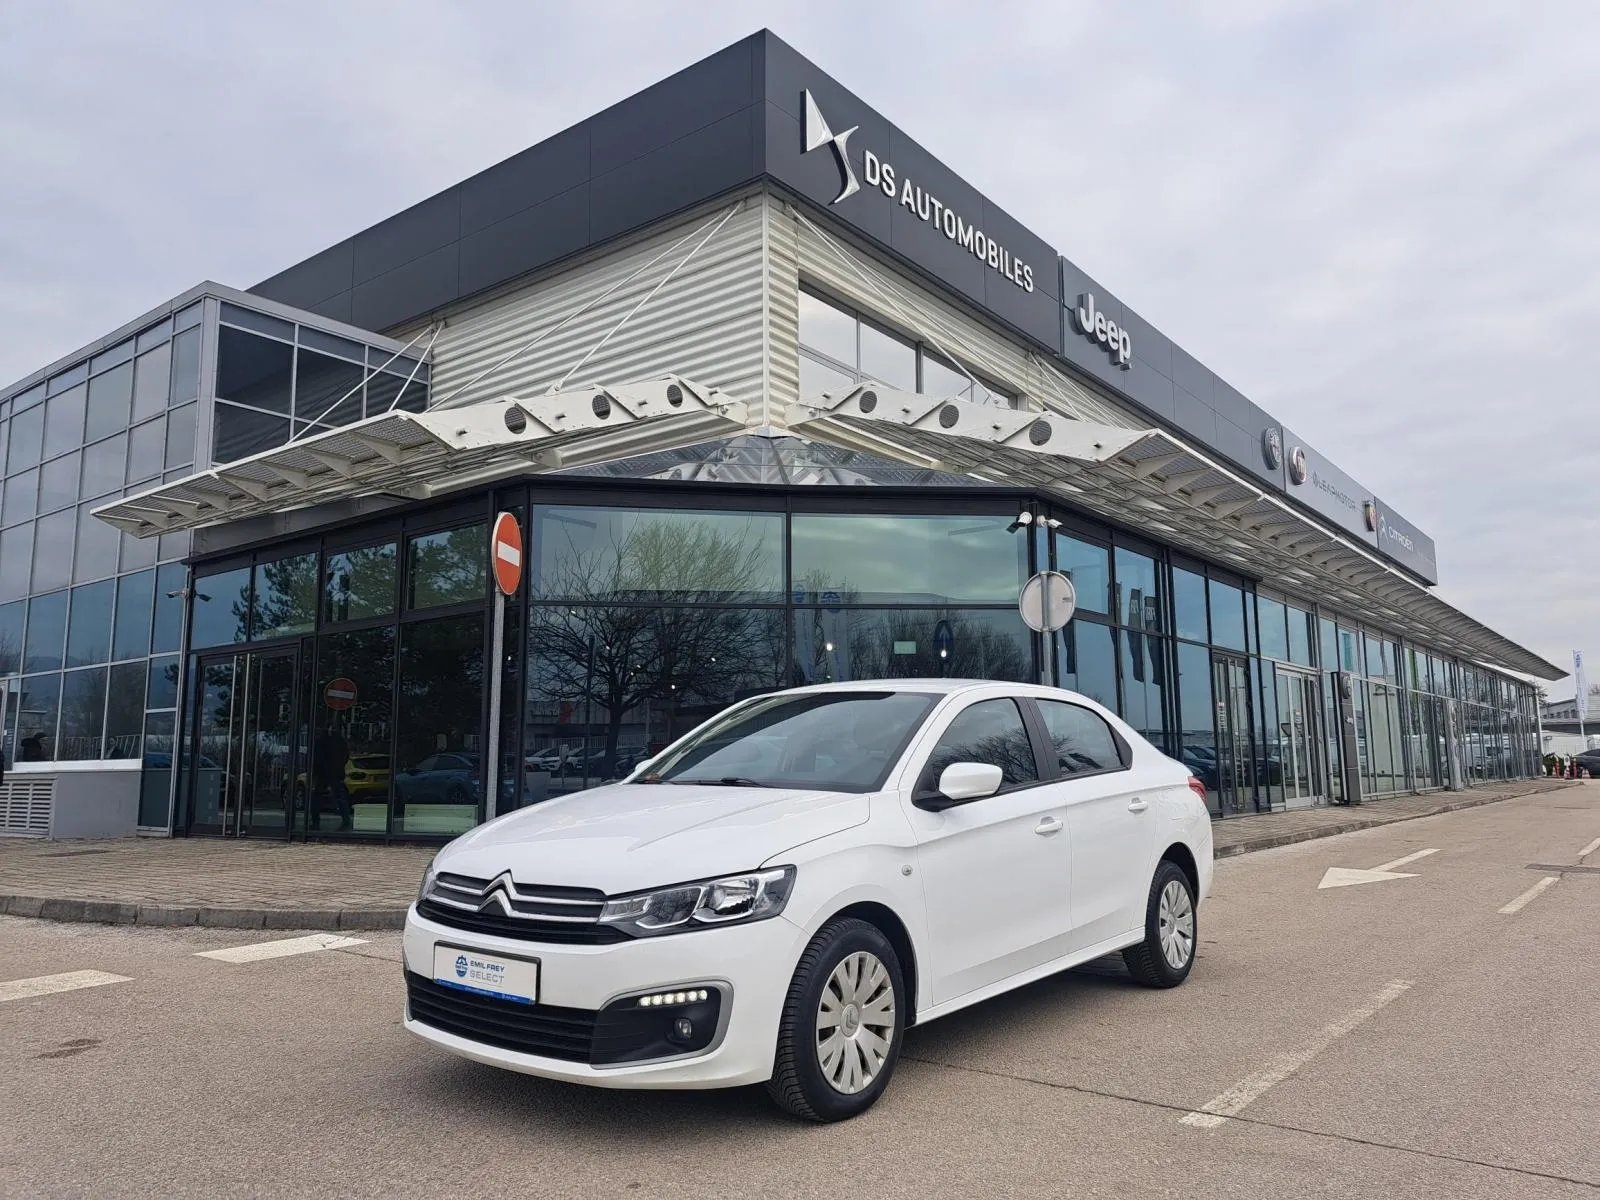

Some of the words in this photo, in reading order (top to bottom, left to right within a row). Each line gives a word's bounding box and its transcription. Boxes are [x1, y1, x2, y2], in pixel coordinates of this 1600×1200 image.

[864, 149, 896, 197] DS
[900, 178, 1034, 293] AUTOMOBILES
[1075, 292, 1132, 368] Jeep
[470, 960, 486, 970] EMIL
[486, 963, 505, 973] FREY
[470, 970, 505, 984] SELECT
